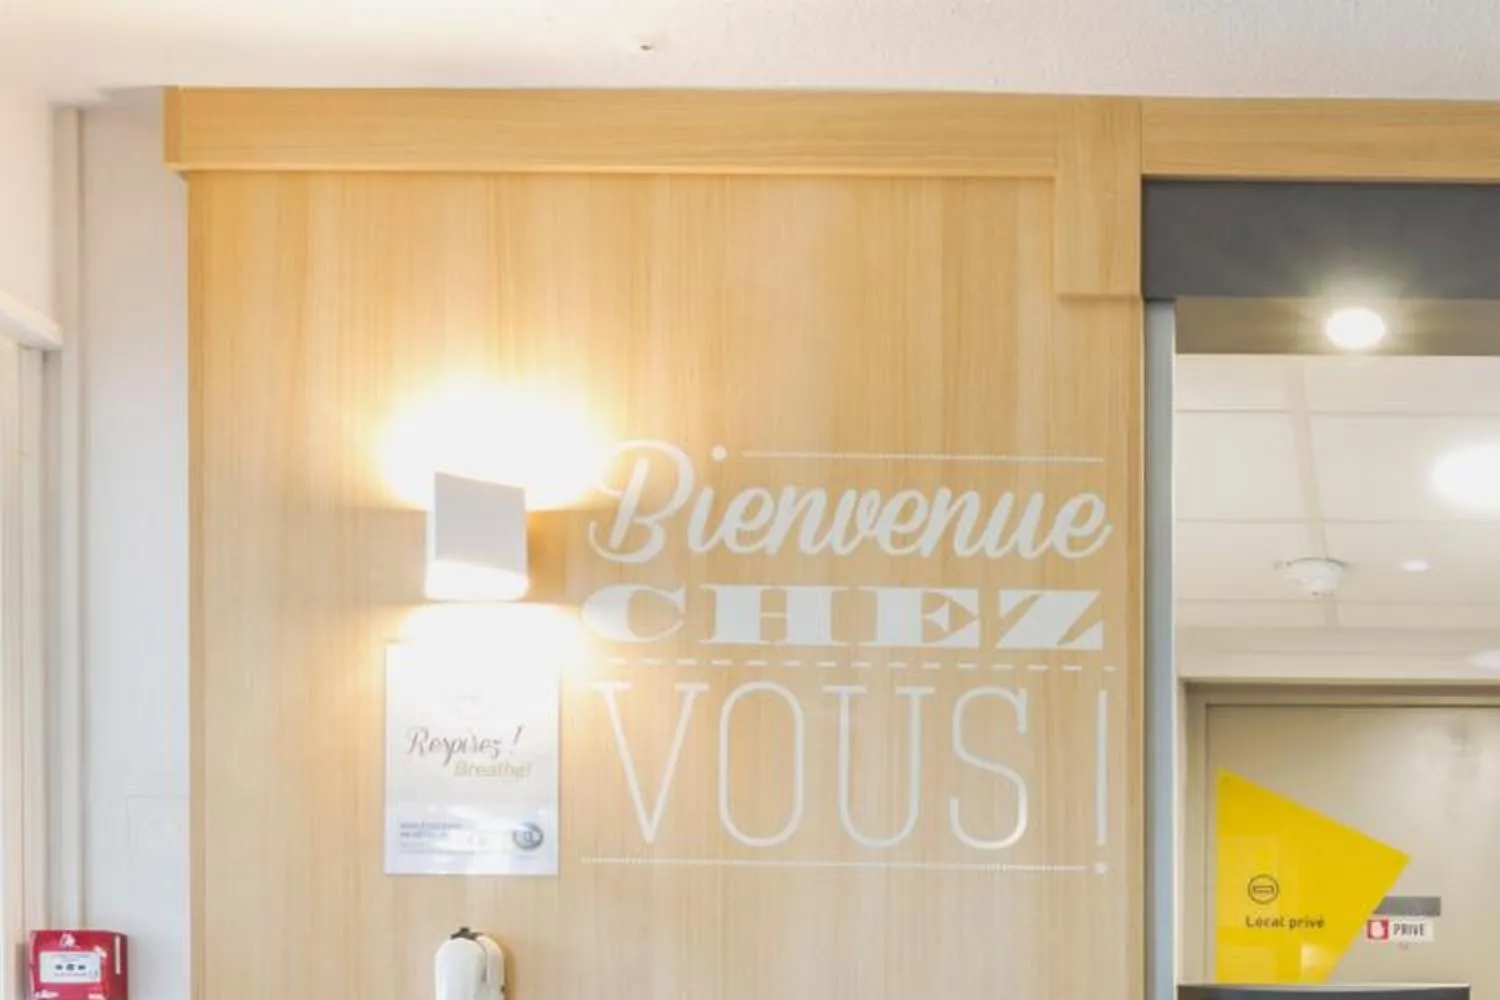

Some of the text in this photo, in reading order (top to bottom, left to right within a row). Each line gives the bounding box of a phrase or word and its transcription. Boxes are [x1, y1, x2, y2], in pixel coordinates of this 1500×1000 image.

[588, 440, 1114, 564] Bienvenue
[580, 583, 1104, 652] CHEZ
[1245, 914, 1326, 931] Local privé
